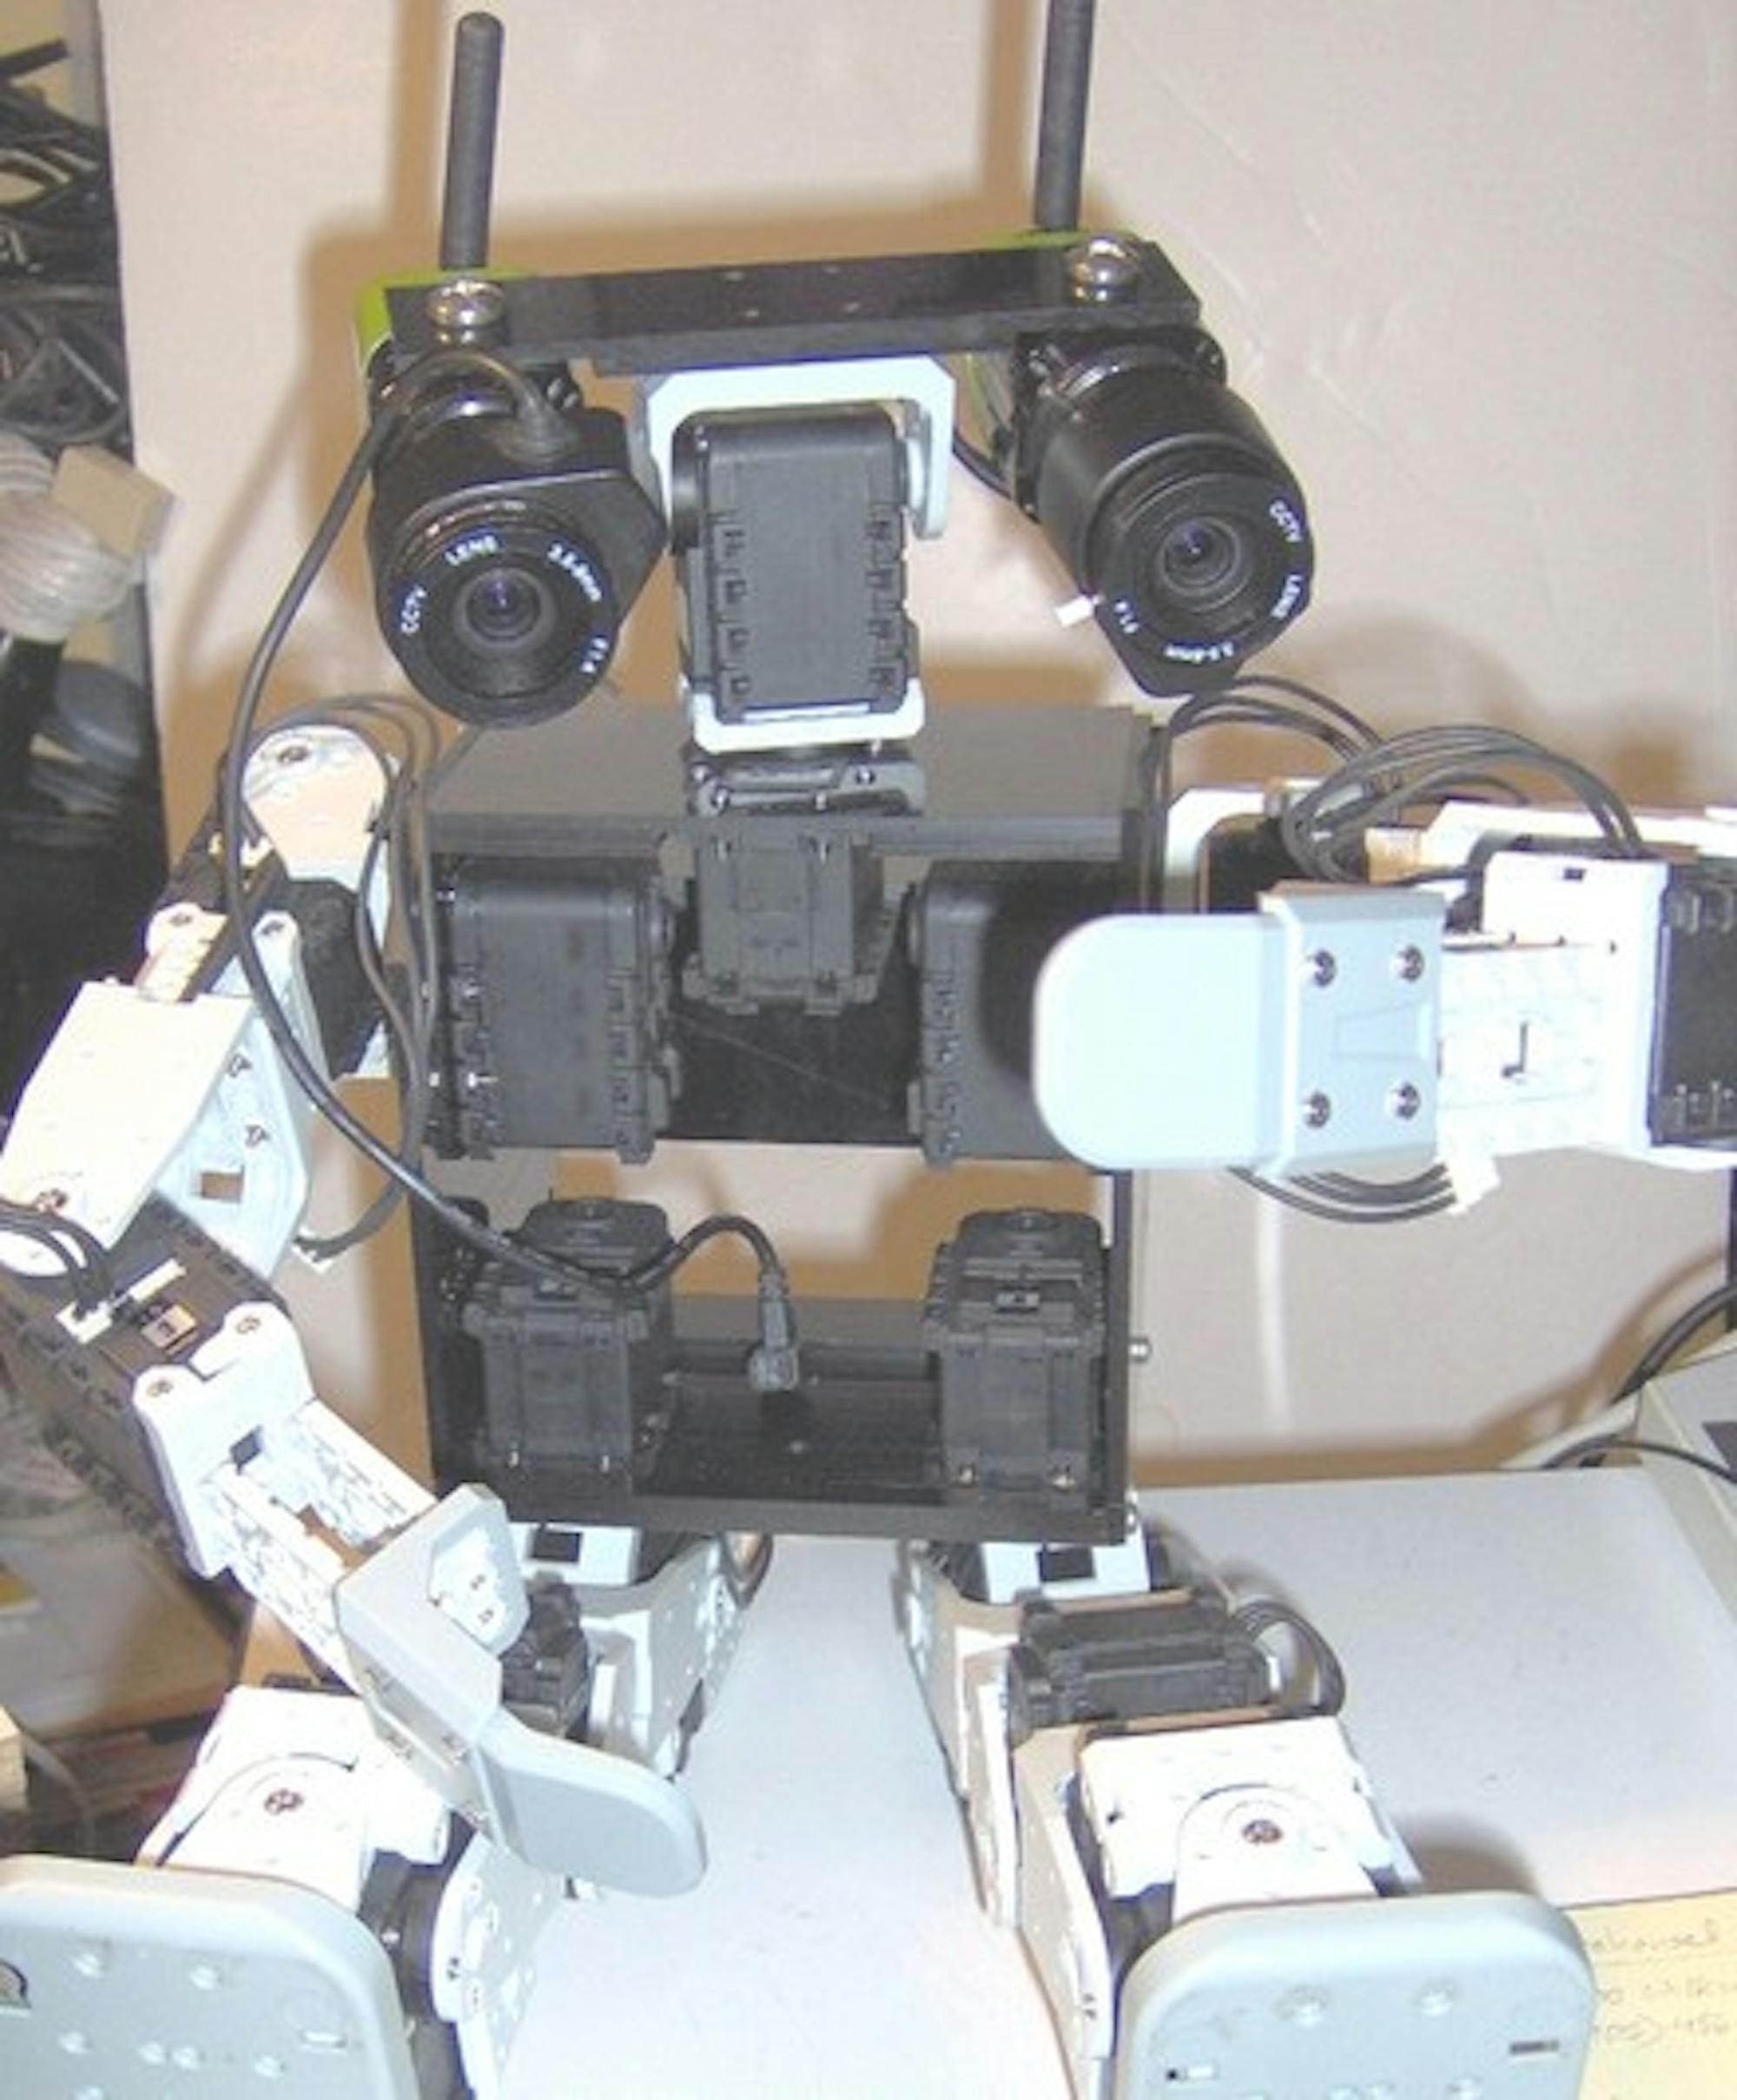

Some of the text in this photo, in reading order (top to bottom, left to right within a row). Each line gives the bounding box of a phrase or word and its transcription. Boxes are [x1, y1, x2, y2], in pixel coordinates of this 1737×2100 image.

[1269, 499, 1302, 543] CCTV
[400, 584, 427, 635] CCTV
[445, 534, 498, 566] LENS
[1271, 574, 1302, 619] LENS
